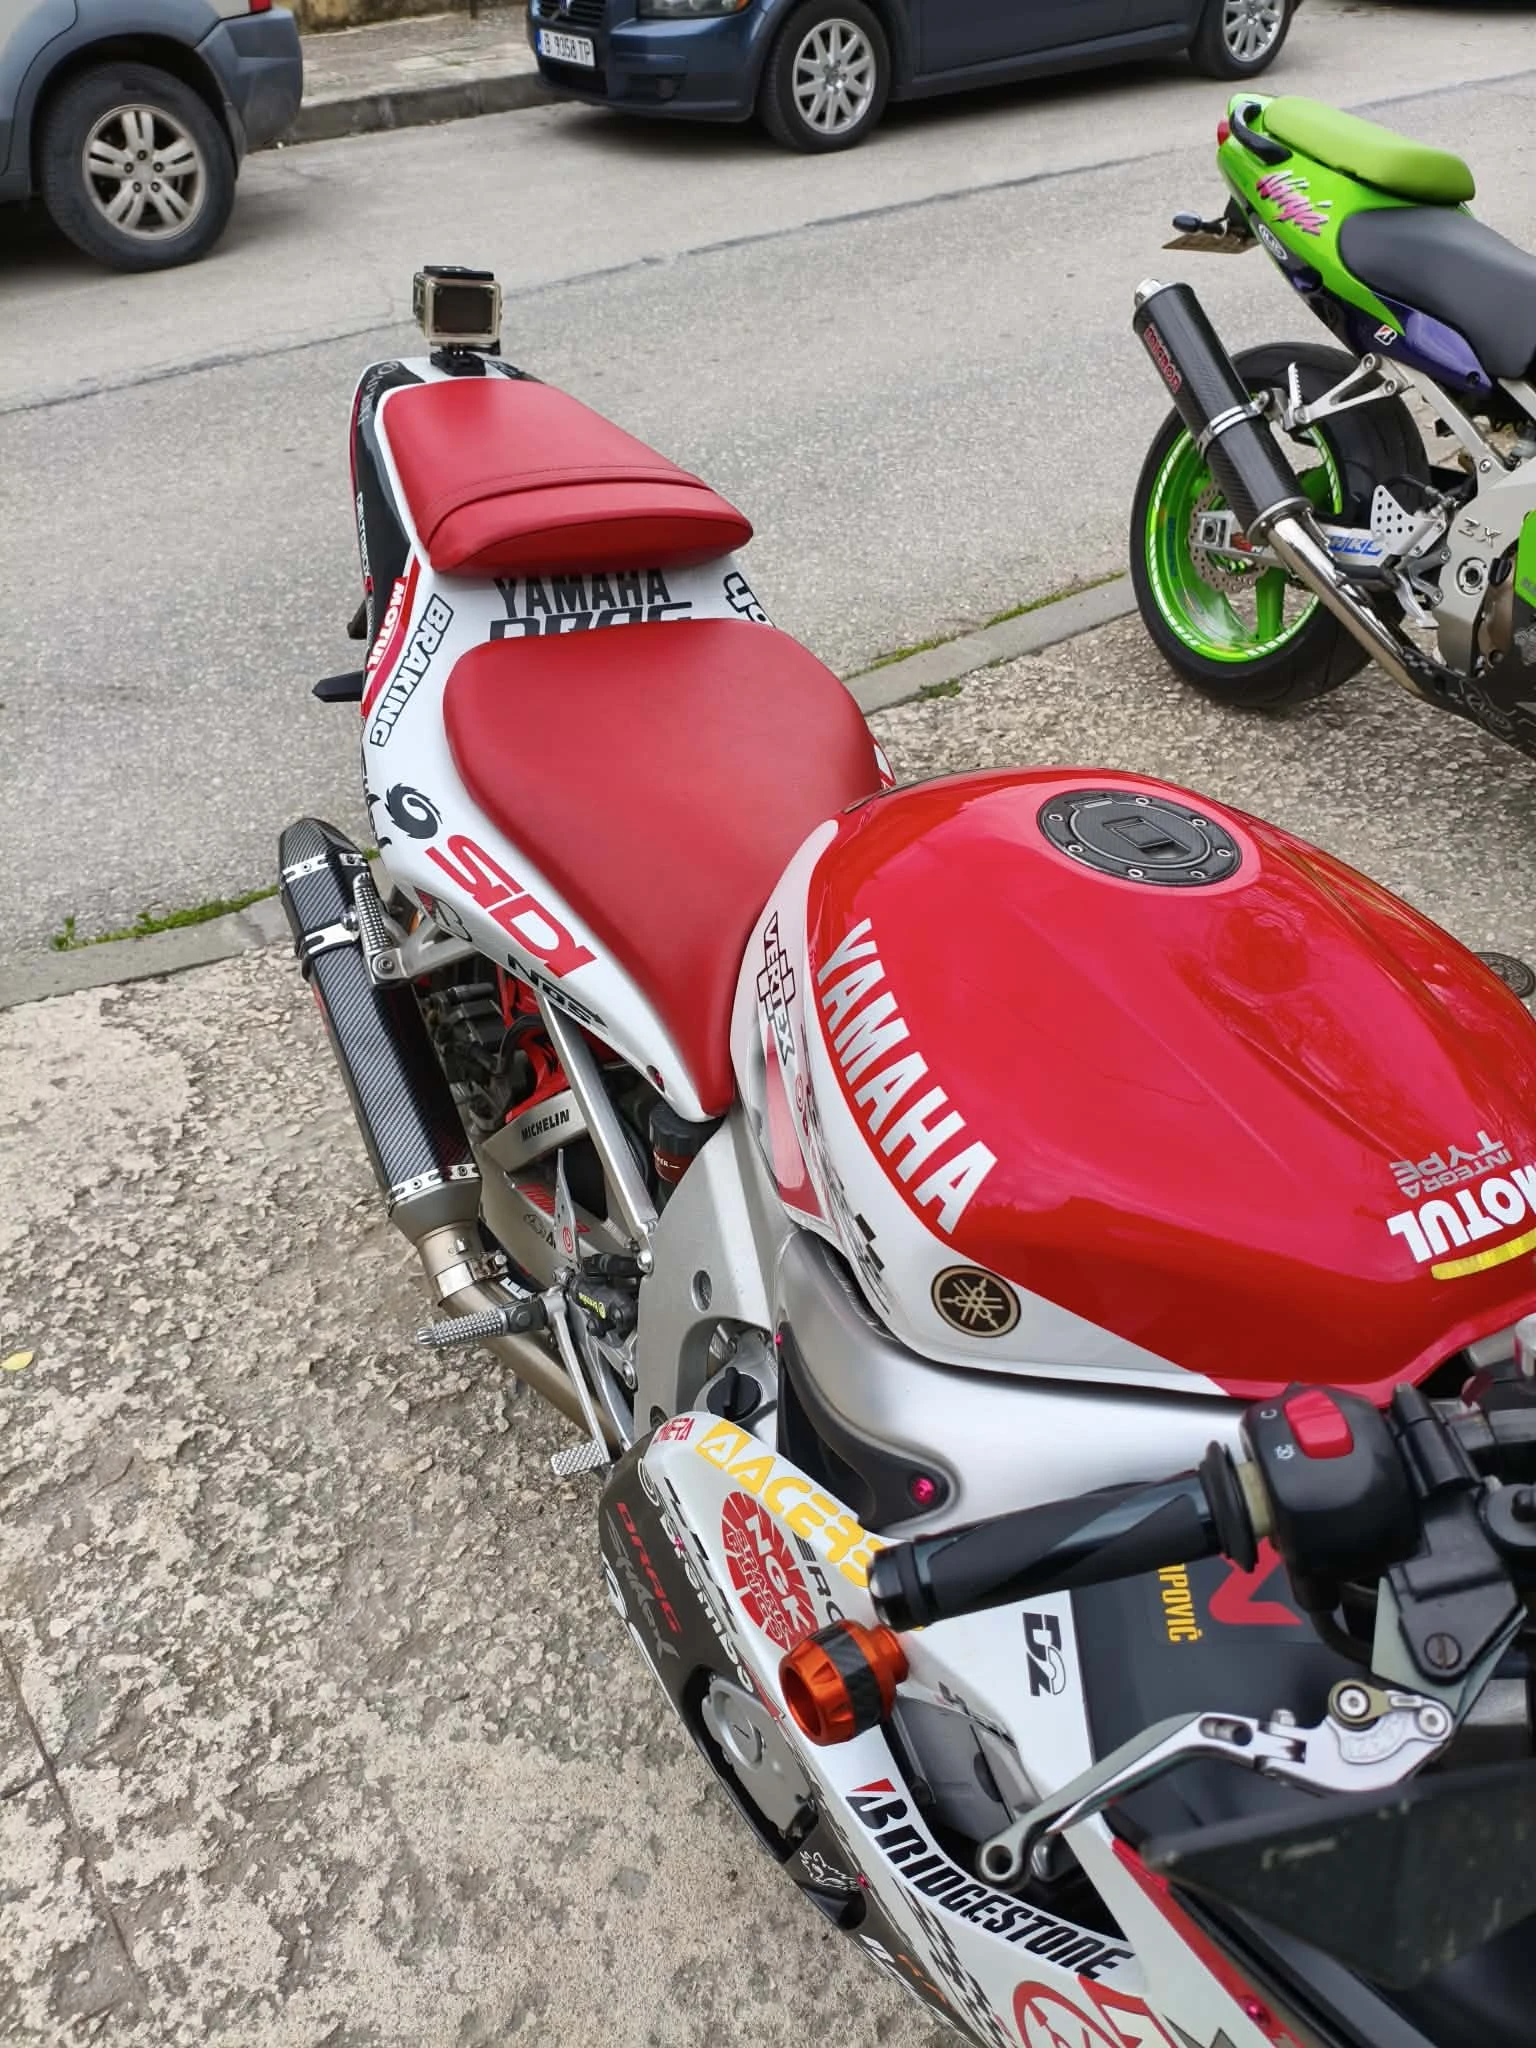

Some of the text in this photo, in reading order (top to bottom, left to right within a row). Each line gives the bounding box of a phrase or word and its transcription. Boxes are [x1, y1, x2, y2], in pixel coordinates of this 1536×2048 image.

[366, 582, 405, 672] MOTUL
[494, 568, 671, 618] YAMAHA
[369, 593, 454, 748] BRAKING
[764, 911, 796, 1066] VERTEX
[521, 1109, 570, 1142] MICHELIN
[817, 918, 998, 1234] YAMAHA
[1390, 1130, 1504, 1185] TYPE
[744, 1514, 811, 1632] NGK
[846, 1779, 1136, 1981] BRIDGESTONE
